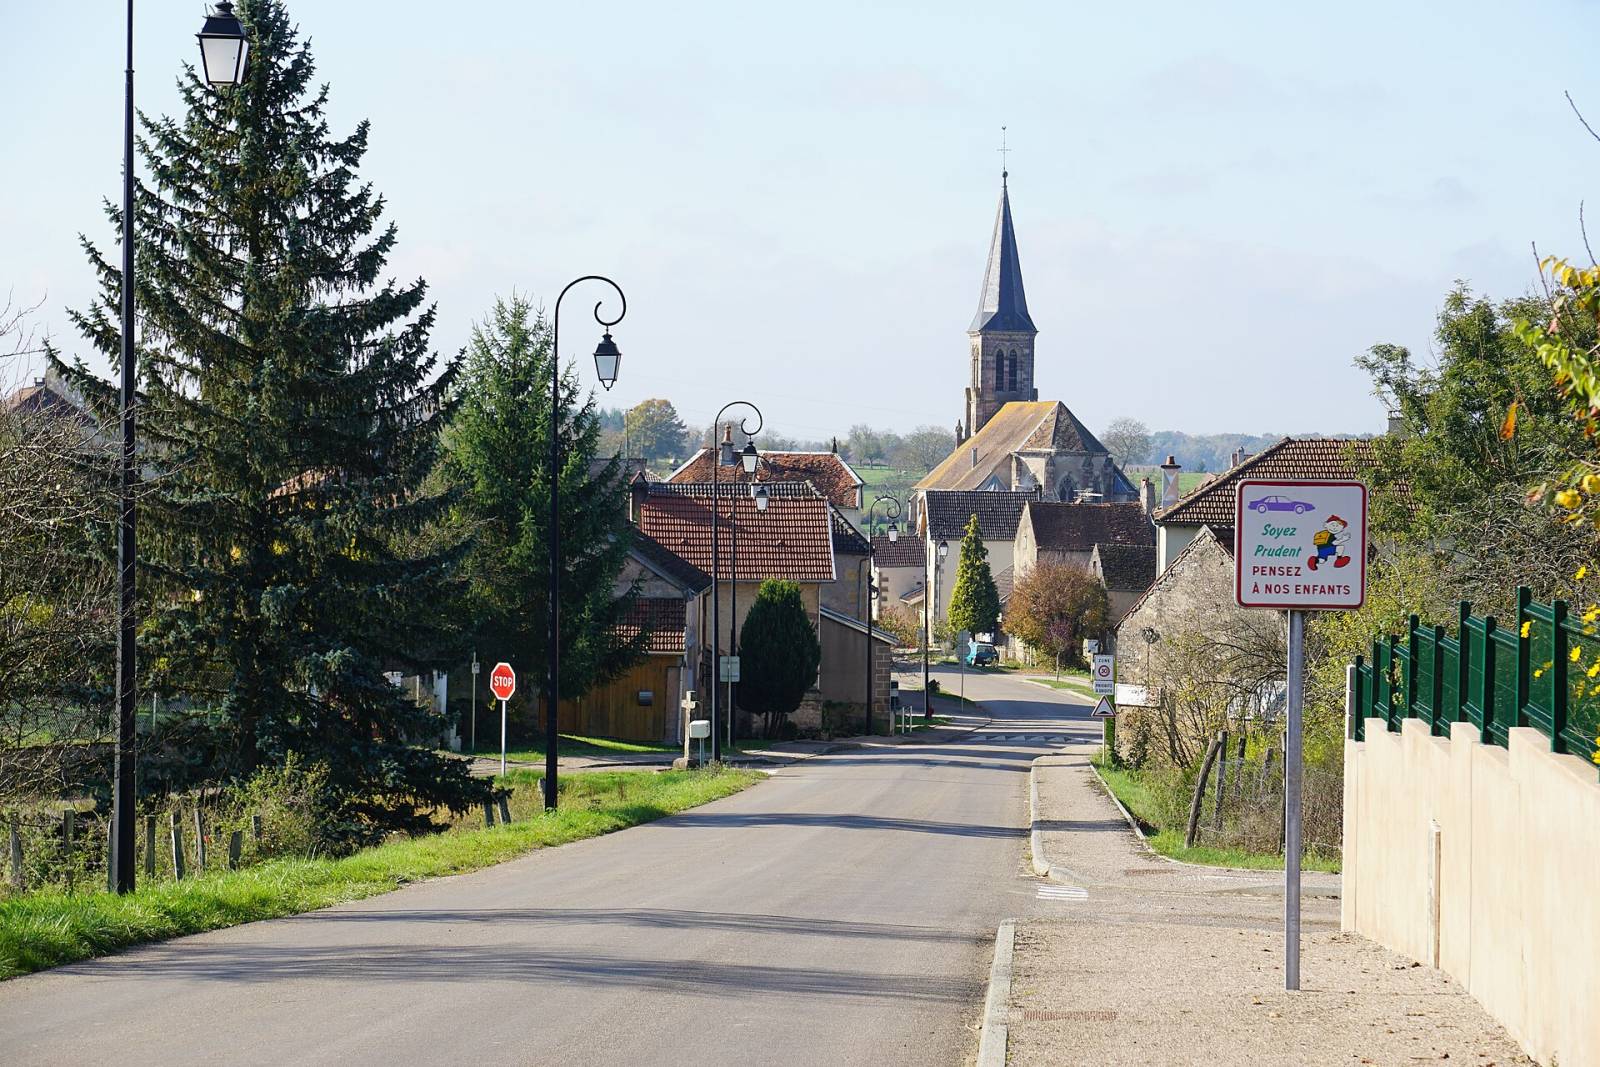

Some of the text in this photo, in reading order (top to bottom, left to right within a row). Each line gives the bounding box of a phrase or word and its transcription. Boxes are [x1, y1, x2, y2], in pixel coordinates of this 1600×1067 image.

[1262, 523, 1297, 540] Soyez
[1254, 545, 1302, 557] Prudent
[1252, 566, 1302, 577] PENSEZ
[1252, 582, 1351, 595] À NOS ENFANTS
[494, 676, 512, 687] STOP
